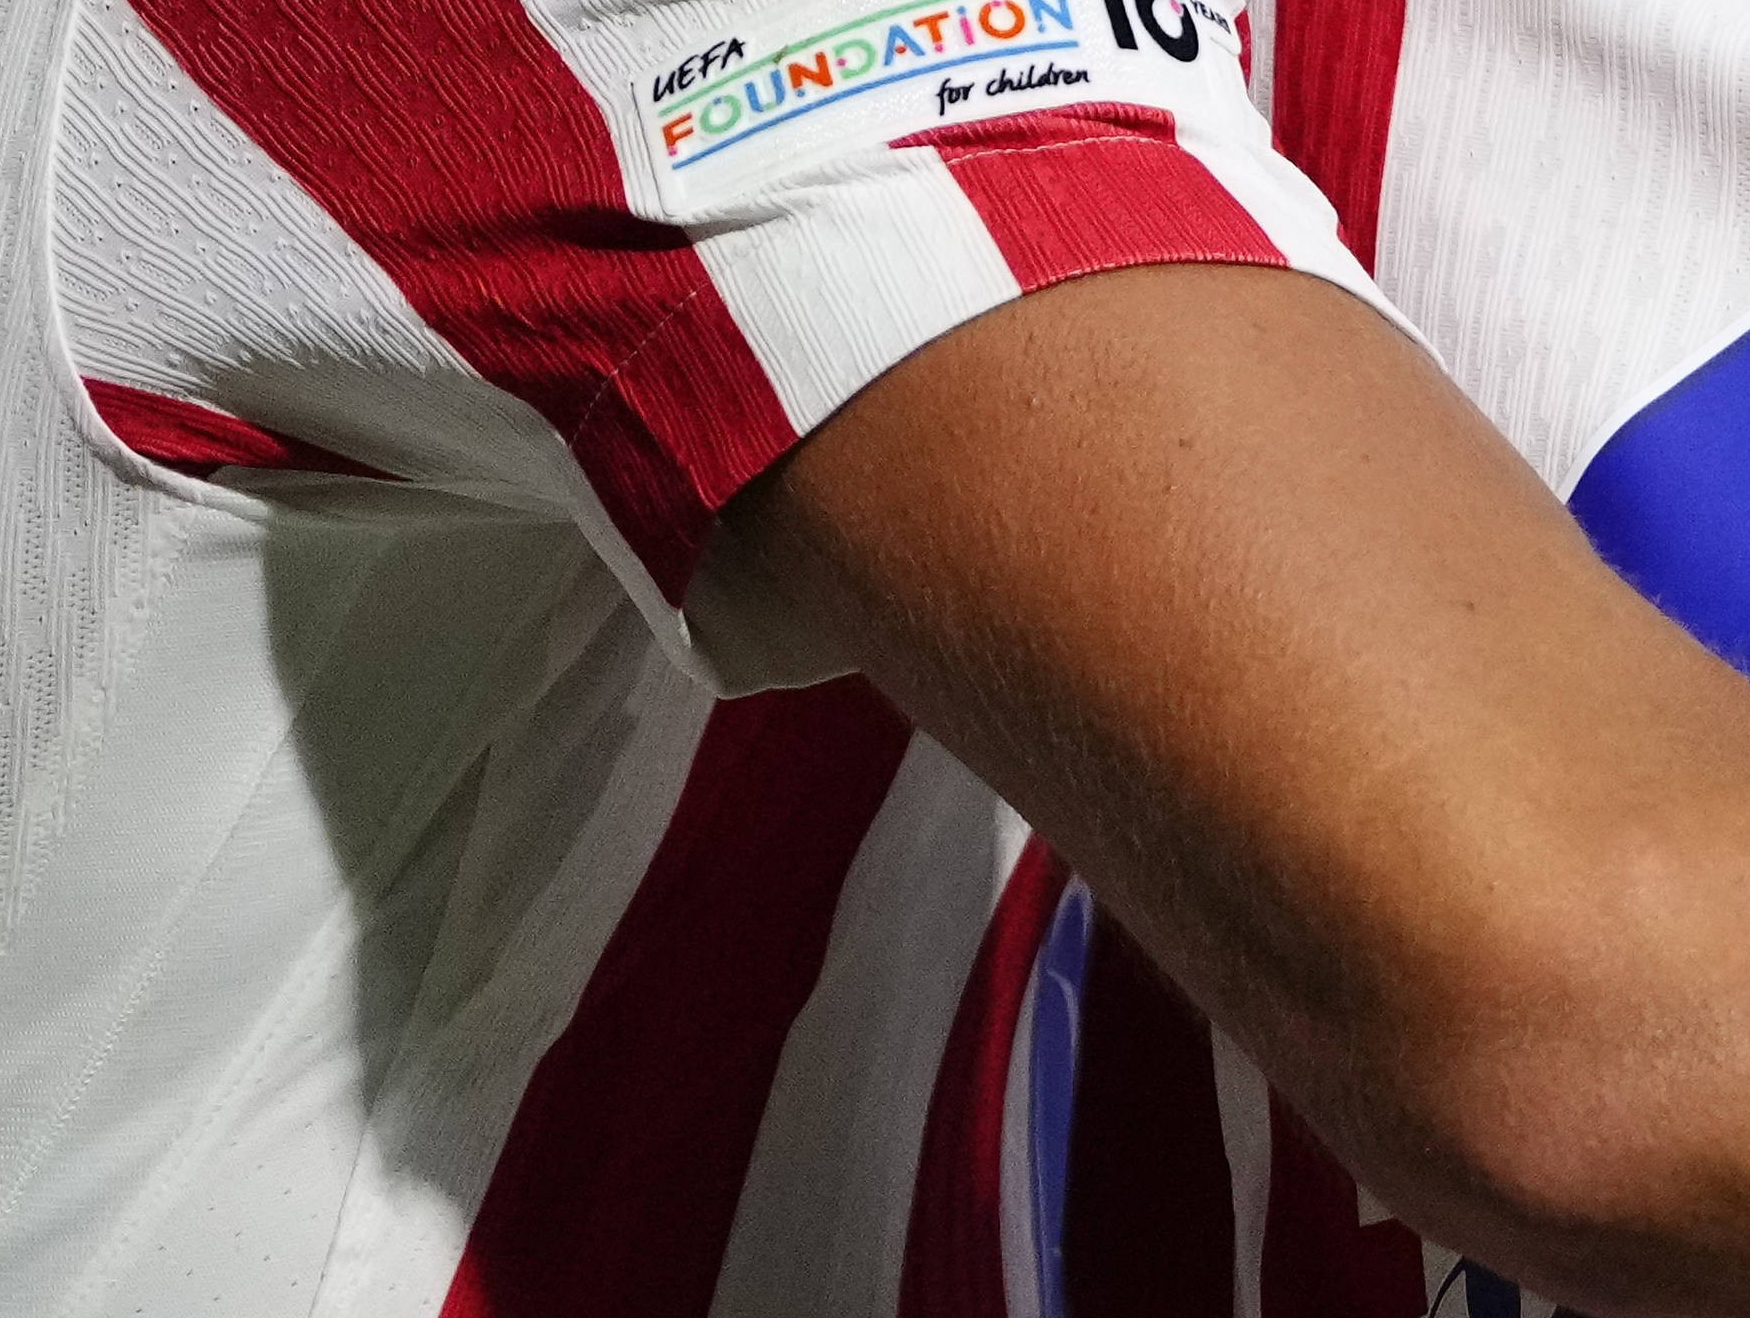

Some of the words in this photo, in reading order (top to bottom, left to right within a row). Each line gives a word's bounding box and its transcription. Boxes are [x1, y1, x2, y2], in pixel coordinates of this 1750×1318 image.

[652, 37, 746, 102] UEFA
[936, 77, 975, 116] for
[985, 63, 1090, 96] children
